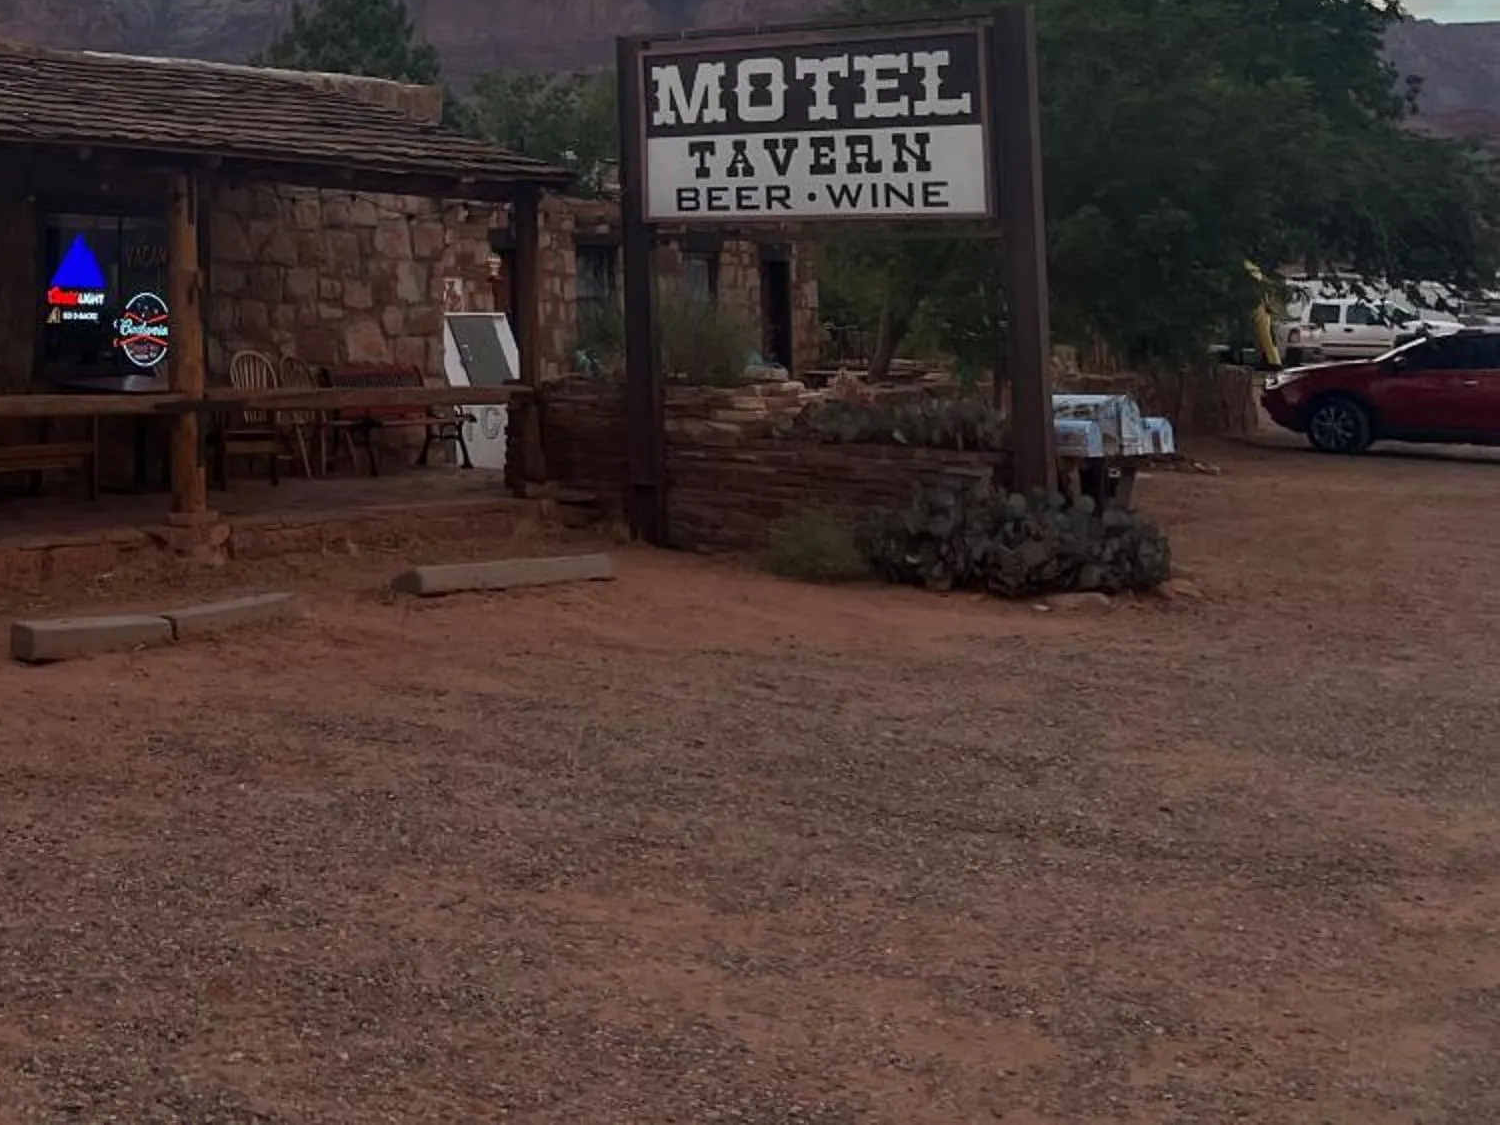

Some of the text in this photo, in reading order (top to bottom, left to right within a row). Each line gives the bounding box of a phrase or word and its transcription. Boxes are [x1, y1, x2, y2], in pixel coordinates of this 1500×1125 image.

[651, 50, 972, 126] MOTEL
[688, 132, 932, 179] TAVERN
[676, 181, 949, 211] BEER WINE
[77, 291, 105, 306] LIGHT
